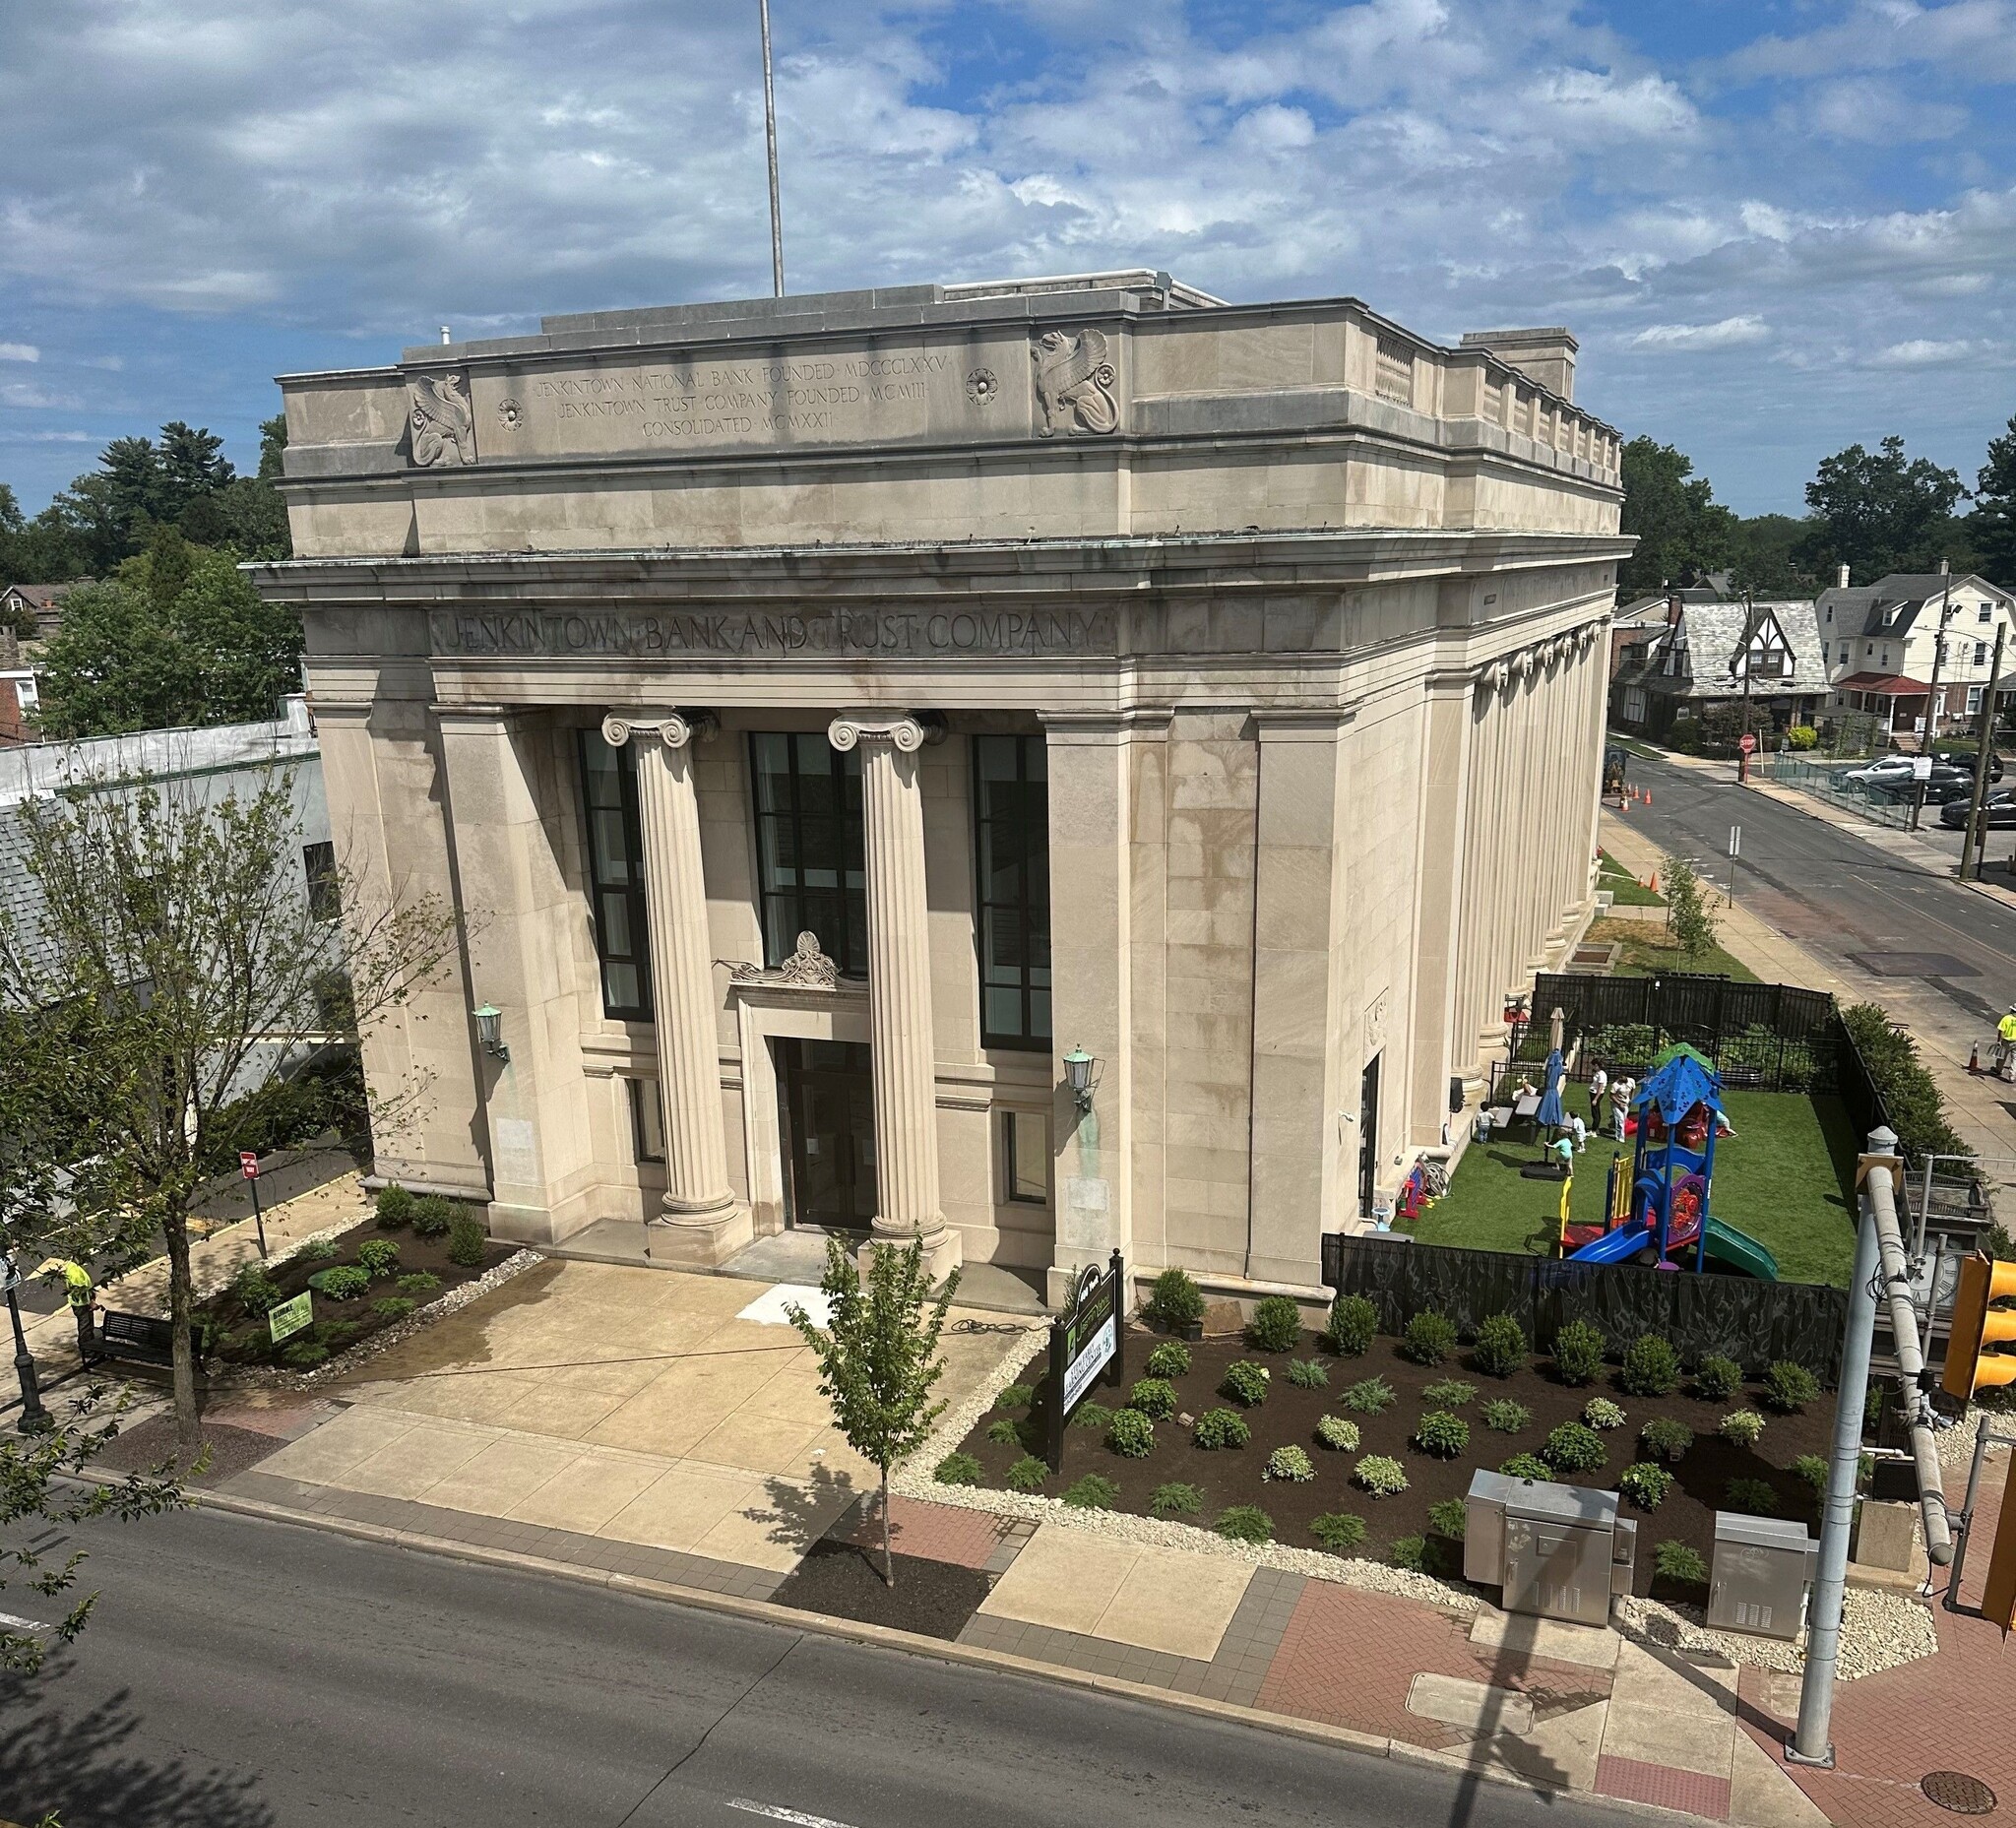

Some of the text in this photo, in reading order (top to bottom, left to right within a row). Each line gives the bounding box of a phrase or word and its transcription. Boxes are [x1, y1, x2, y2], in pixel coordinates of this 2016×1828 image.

[537, 355, 947, 398] JENKINTOWN NATIONAL BANK FOUNDED MDCCCLXXV
[558, 399, 646, 419] JENKINTOWN
[654, 396, 696, 413] TRUST
[705, 391, 778, 410] COMPANY
[788, 386, 859, 406] FOUNDED
[643, 411, 833, 438] CONSOLIDATED MCMXXII
[446, 612, 1098, 650] JENKINTOWN BANK AND TRUST COMPANY
[273, 1303, 293, 1320] BURKE
